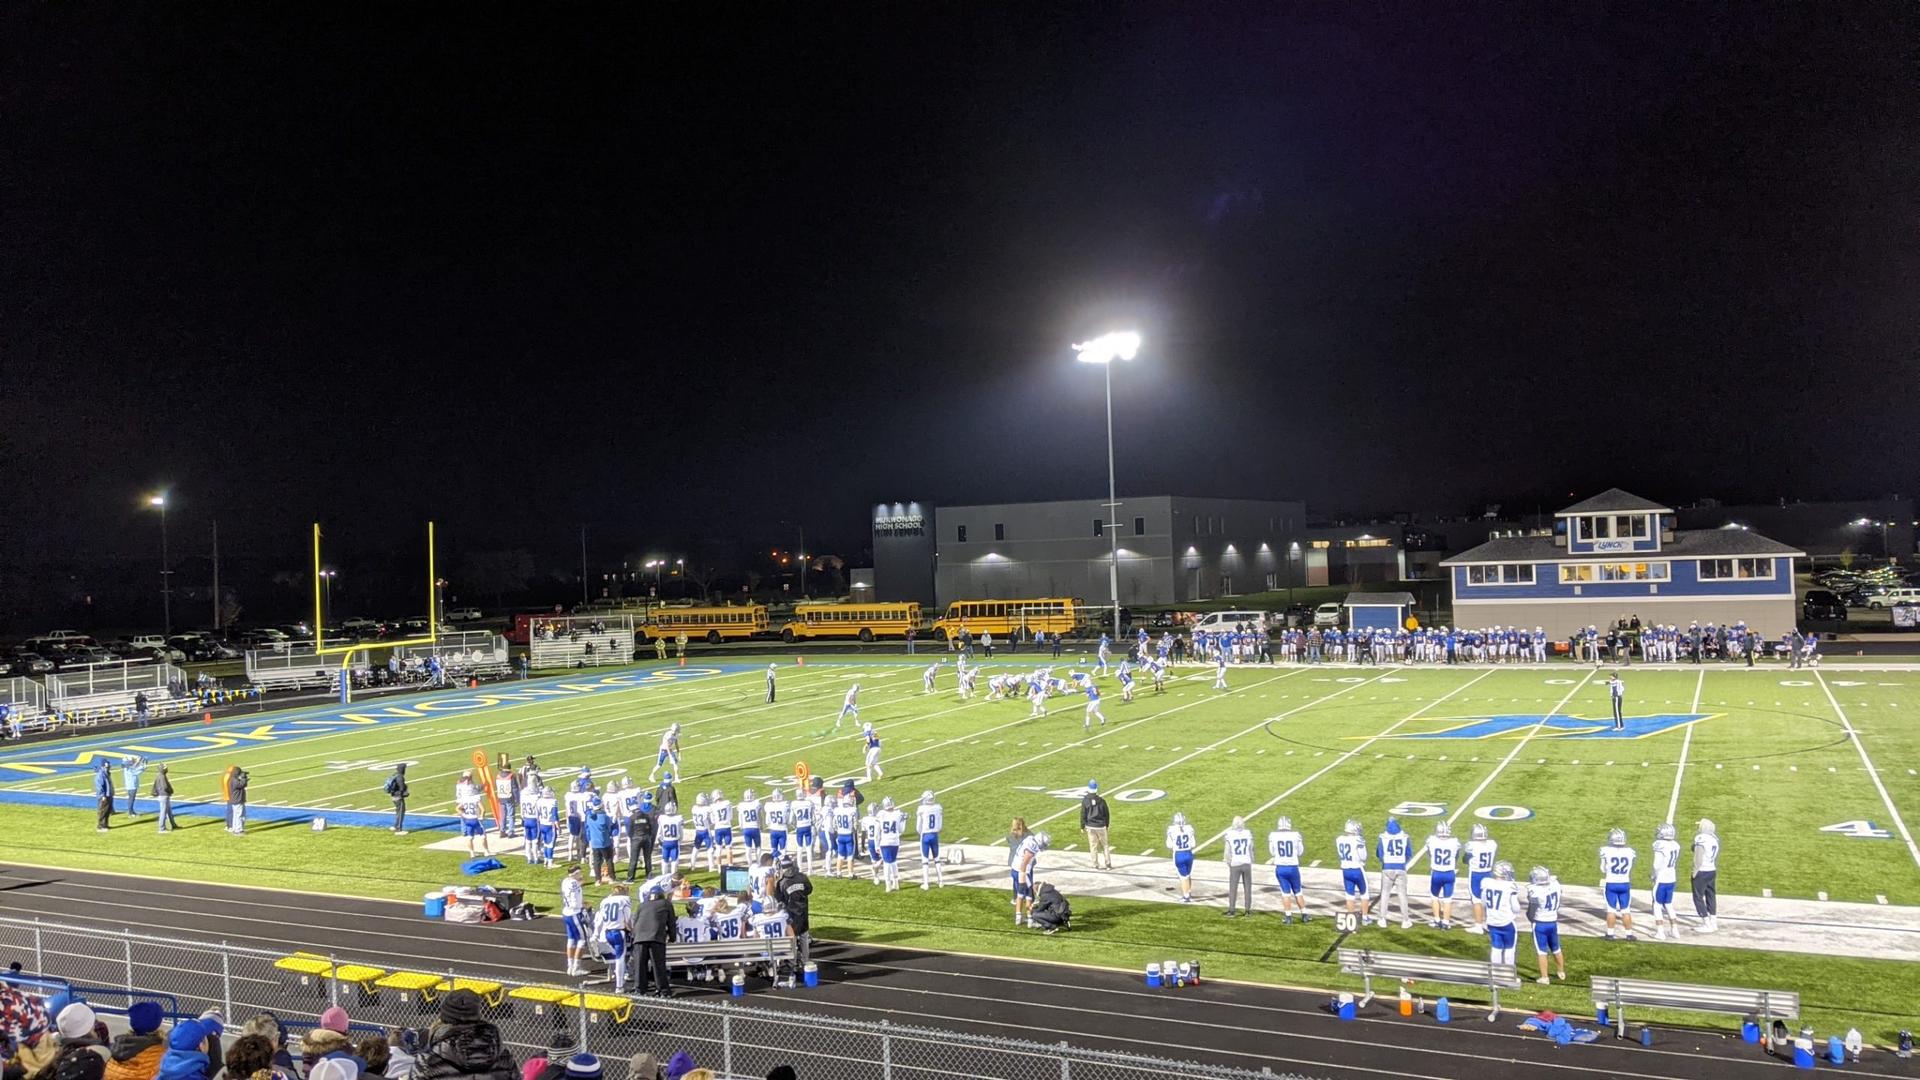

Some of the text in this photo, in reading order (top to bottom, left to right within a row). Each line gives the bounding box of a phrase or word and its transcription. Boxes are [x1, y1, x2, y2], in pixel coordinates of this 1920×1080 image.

[0, 668, 722, 773] MUKWONAGO
[717, 807, 728, 822] 17
[743, 808, 758, 822] 28
[796, 807, 809, 821] 24
[928, 813, 936, 829] 8
[663, 823, 677, 838] 20
[882, 820, 897, 834] 54
[1175, 834, 1189, 849] 42
[1233, 838, 1248, 855] 27
[1277, 840, 1294, 857] 60
[1387, 839, 1404, 856] 45
[1434, 848, 1451, 866] 62
[1479, 852, 1493, 868] 51
[1610, 856, 1629, 875] 22
[1485, 889, 1503, 910] 97
[1544, 892, 1560, 911] 47
[602, 902, 620, 922] 30
[720, 918, 739, 939] 36
[763, 922, 782, 938] 99
[1336, 913, 1357, 931] 50
[684, 927, 698, 943] 21
